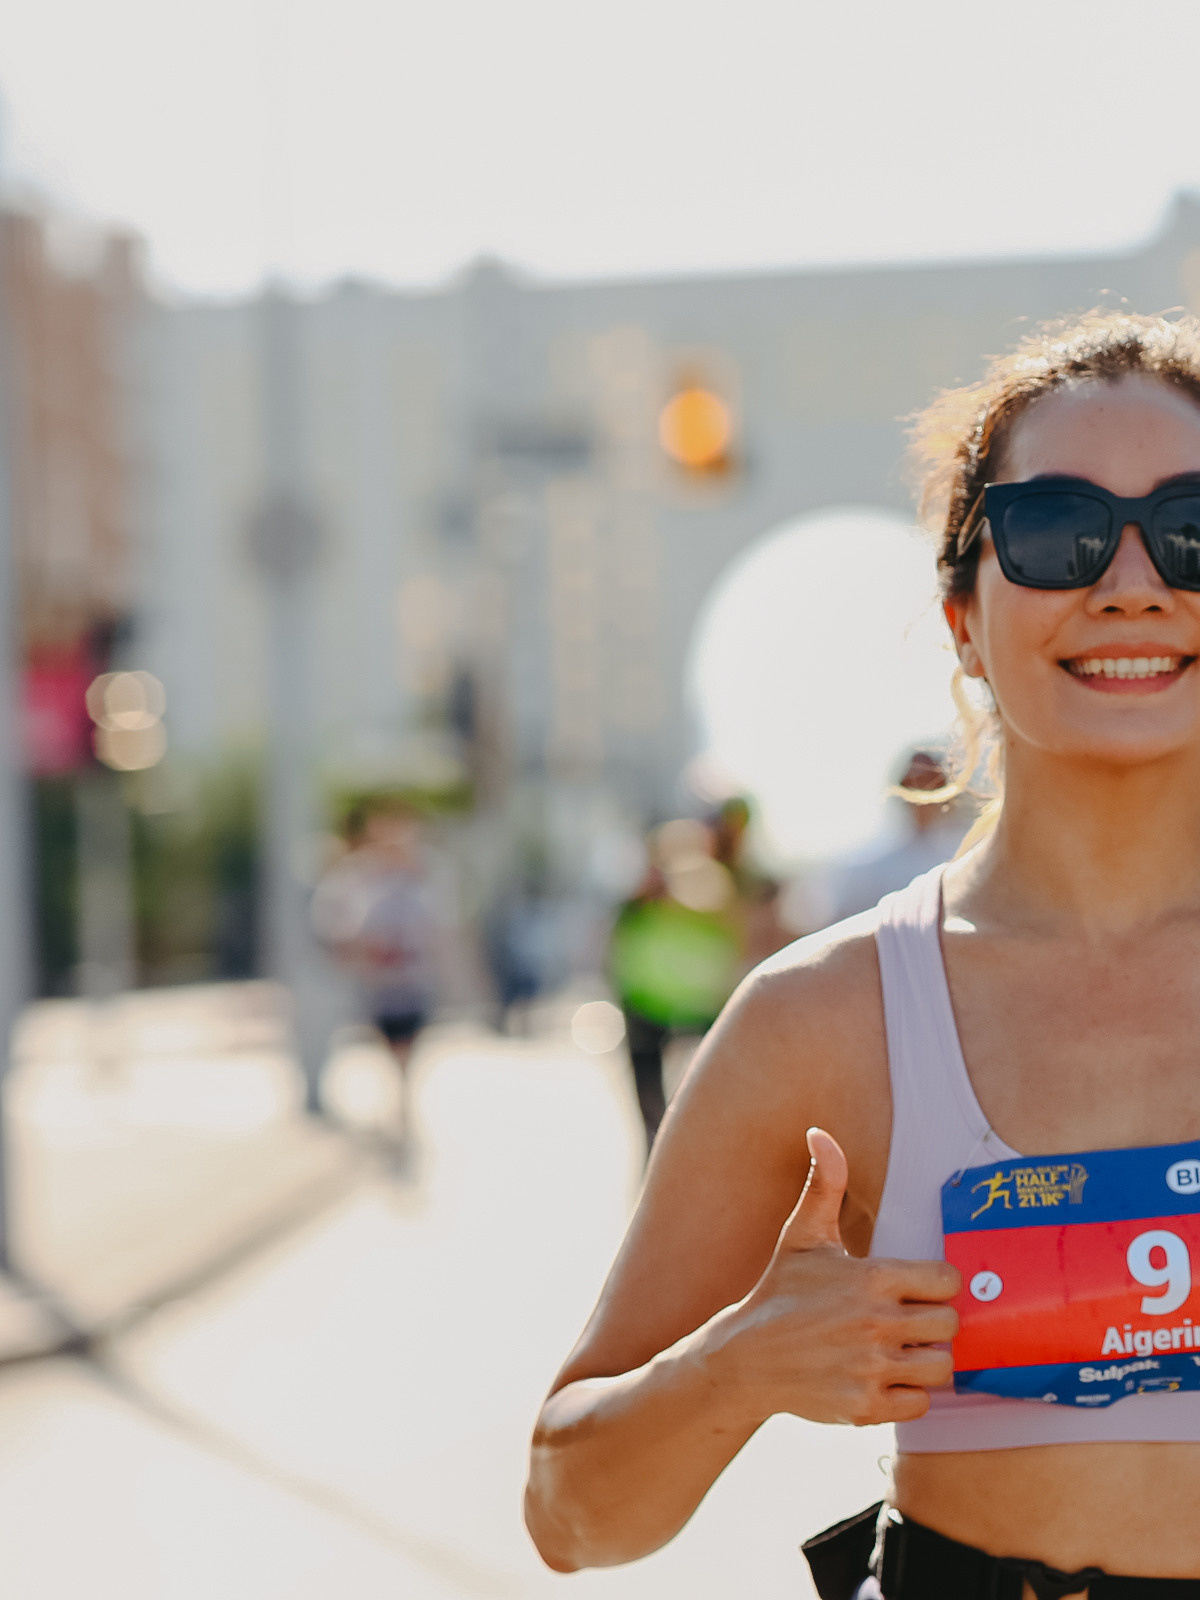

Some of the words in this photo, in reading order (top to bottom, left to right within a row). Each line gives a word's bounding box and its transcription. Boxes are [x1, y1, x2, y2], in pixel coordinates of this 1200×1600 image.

[1016, 1171, 1059, 1187] HALF
[1126, 1229, 1191, 1315] 9
[1078, 1359, 1161, 1383] Sulpak
